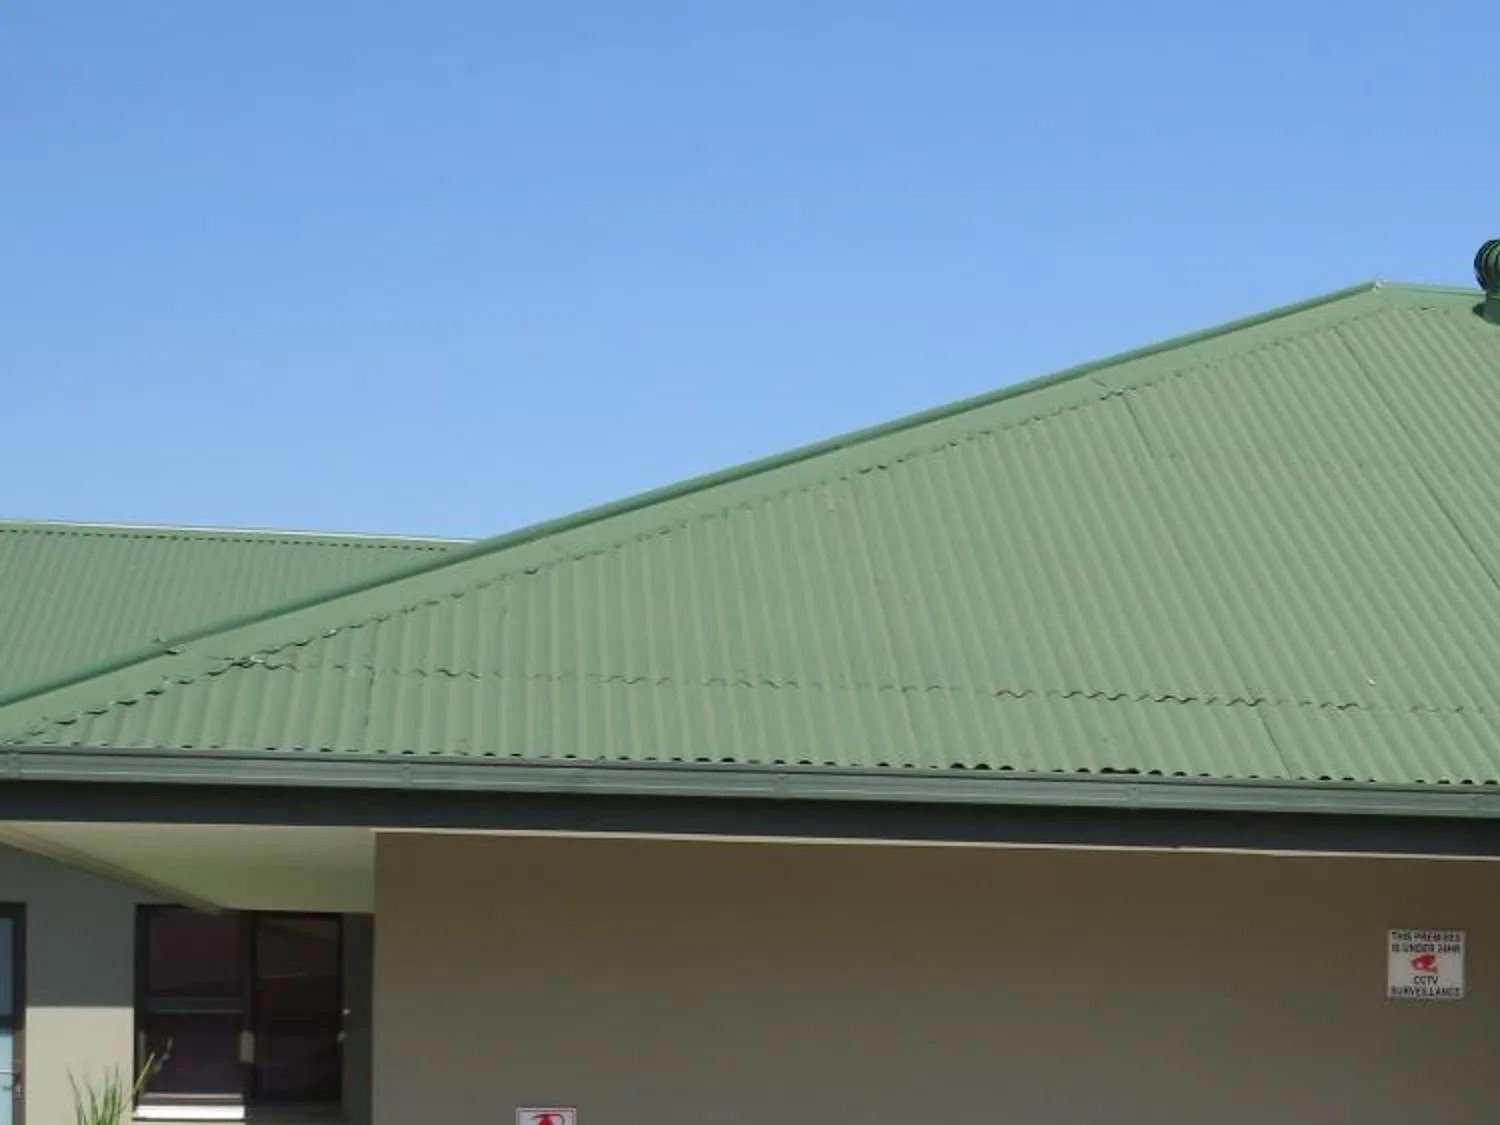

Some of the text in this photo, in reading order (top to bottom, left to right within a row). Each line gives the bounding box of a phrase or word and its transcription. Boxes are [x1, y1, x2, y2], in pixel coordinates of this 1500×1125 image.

[1414, 931, 1460, 941] PREMISES
[1391, 944, 1400, 953] IS
[1402, 943, 1435, 953] UNDER
[1414, 975, 1439, 984] CCTV
[1391, 986, 1460, 997] SURVEILLANCE
